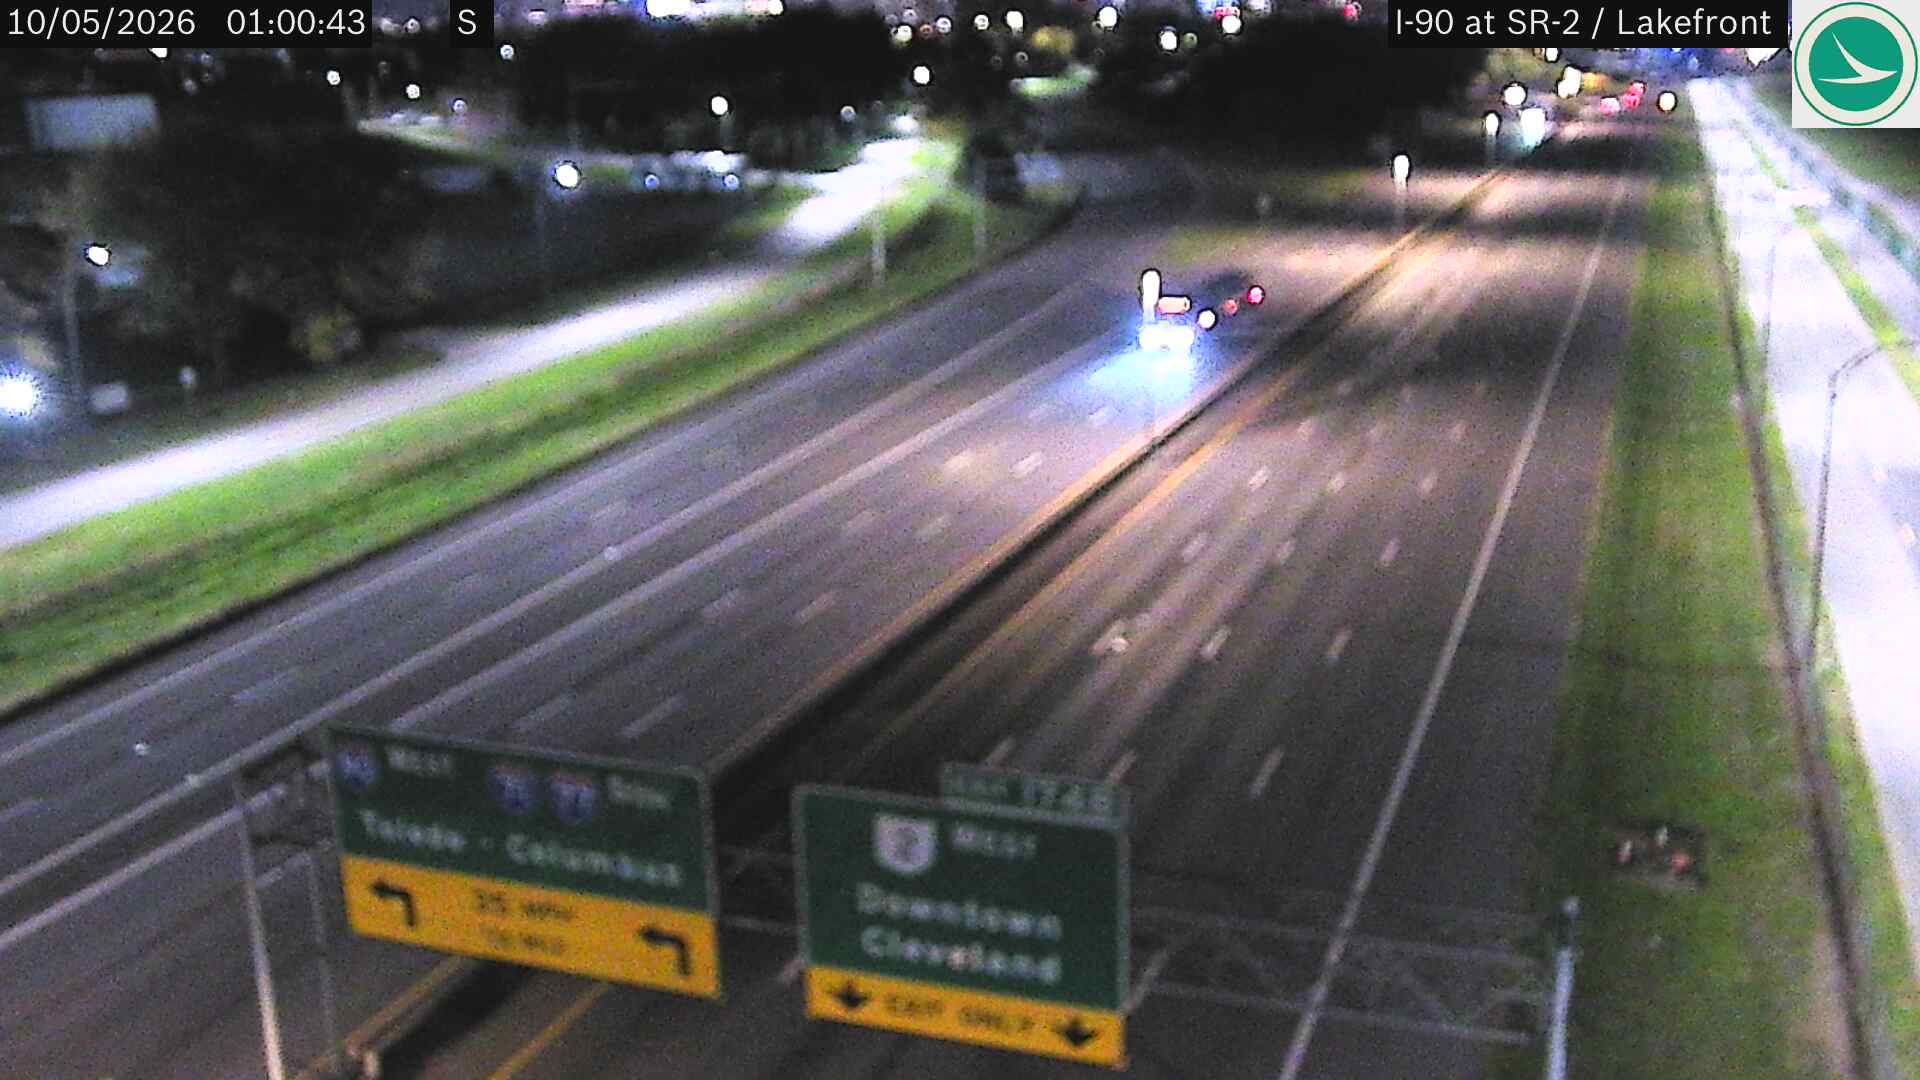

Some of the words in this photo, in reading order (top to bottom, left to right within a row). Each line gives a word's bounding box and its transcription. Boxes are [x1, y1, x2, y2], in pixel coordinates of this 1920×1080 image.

[358, 807, 467, 852] Toledo
[506, 833, 682, 888] Columbus
[856, 881, 1062, 942] Downtown
[860, 924, 1062, 985] Cleveland
